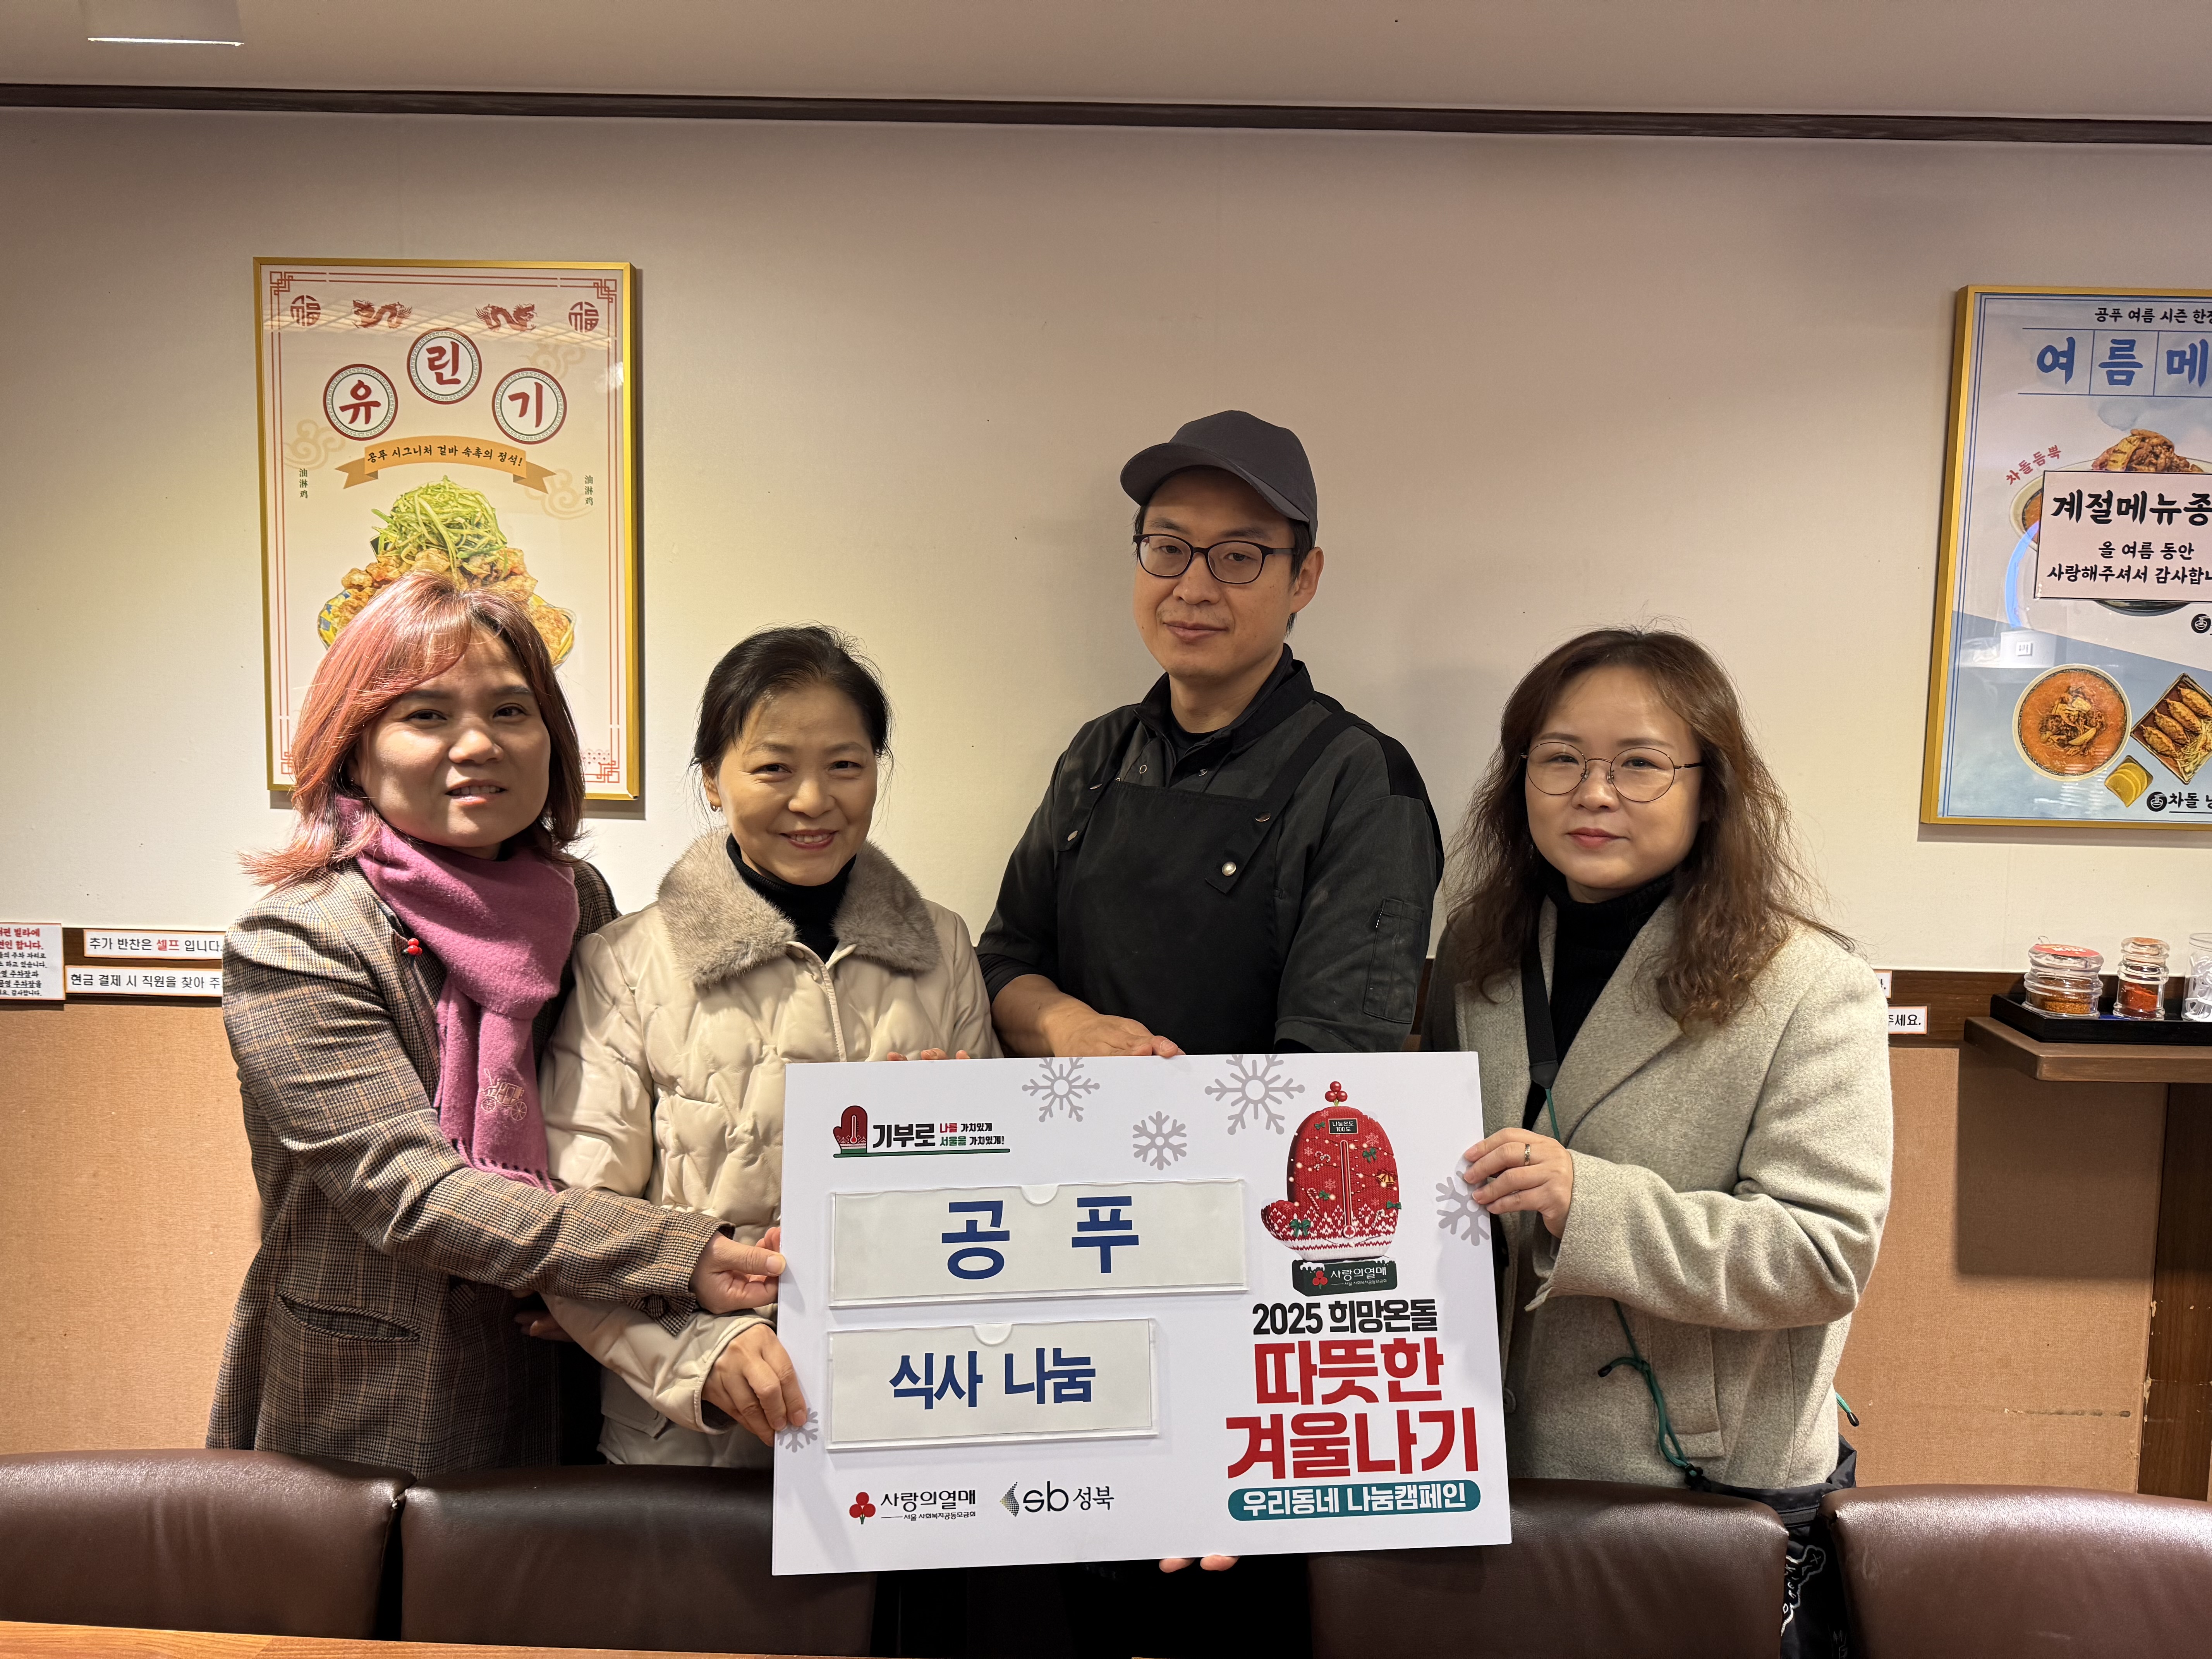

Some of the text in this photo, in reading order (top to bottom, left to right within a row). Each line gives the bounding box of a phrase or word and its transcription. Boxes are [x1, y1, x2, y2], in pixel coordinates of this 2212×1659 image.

[2095, 307, 2123, 322] 공푸
[2128, 308, 2155, 323] 여름
[2160, 309, 2187, 323] 시즌
[367, 450, 387, 463] 공푸
[392, 445, 432, 457] 시그니처
[462, 447, 493, 459] 속촉의
[498, 452, 522, 466] 정석!
[2098, 541, 2194, 560] 올 여름 동안
[2047, 563, 2148, 582] 사랑해주셔서
[2168, 792, 2200, 809] 차돌
[16, 940, 44, 950] 합니다.
[89, 938, 222, 953] 추가 반찬은 셀프 입니다.
[70, 974, 93, 986] 현금
[98, 975, 121, 987] 결제
[126, 976, 137, 987] 시
[142, 976, 176, 988] 직원을
[181, 976, 204, 989] 찾아
[872, 1123, 936, 1148] 기부로
[940, 1123, 992, 1133] 나를 가치있게
[940, 1136, 1004, 1146] 서울을 가치있게!
[1331, 1266, 1386, 1281] 사랑의열매
[1252, 1299, 1437, 1335] 2025 희망온돌
[889, 1348, 1096, 1410] 식사 나눔
[1254, 1337, 1444, 1405] 따뜻한
[1226, 1407, 1479, 1479] 겨울나기
[880, 1490, 976, 1512] 사랑의열매
[1243, 1482, 1466, 1516] 우리동네 나눔캠페인
